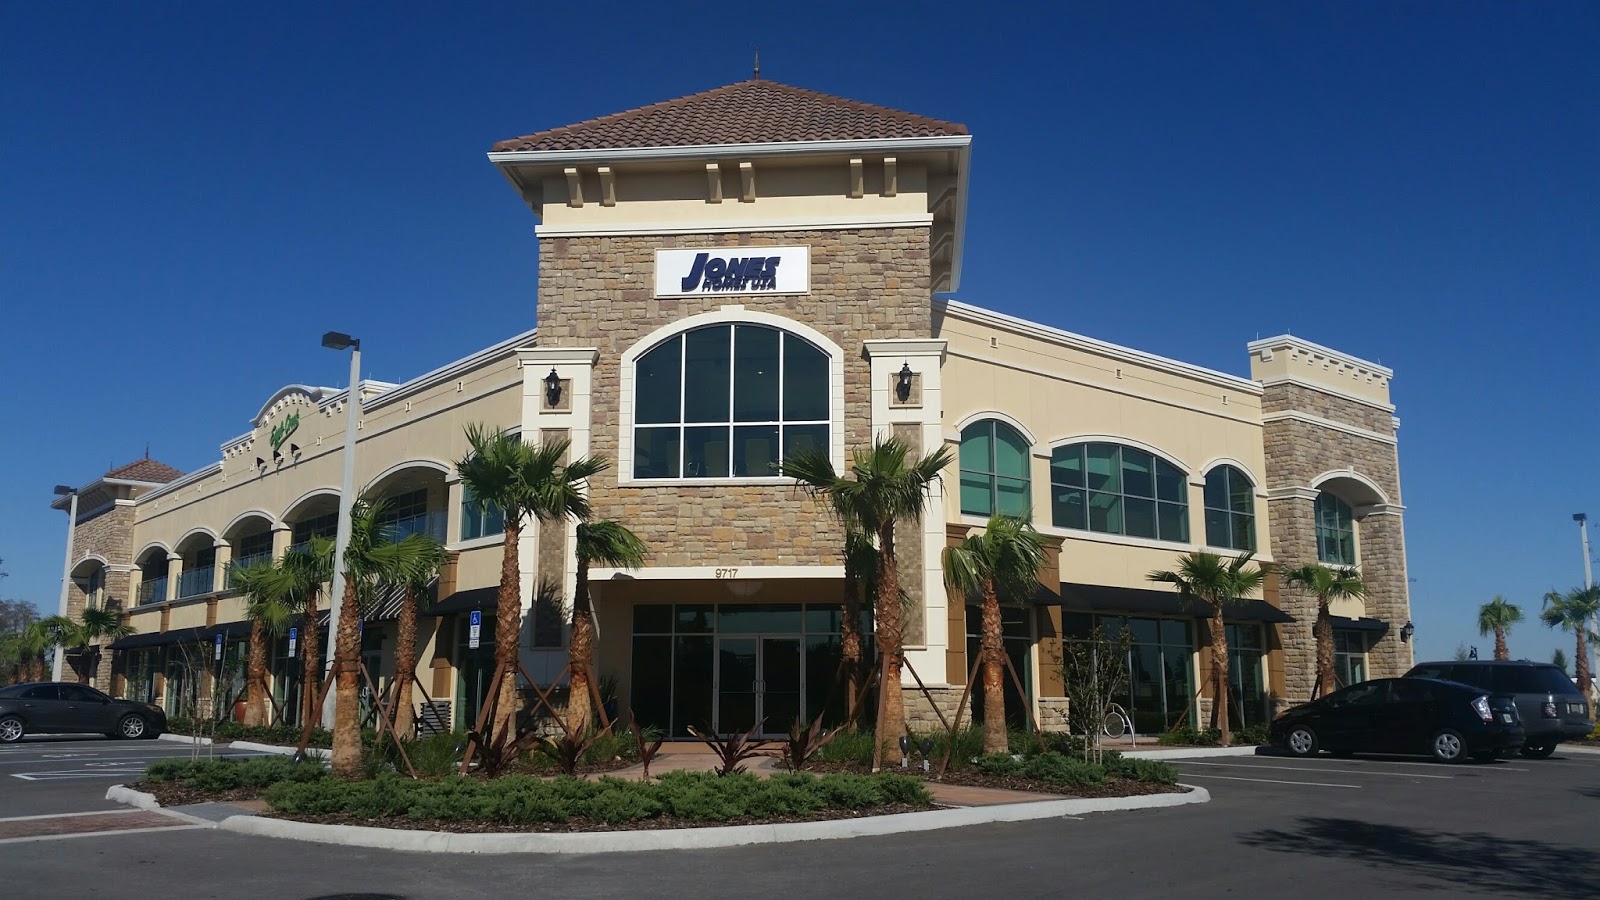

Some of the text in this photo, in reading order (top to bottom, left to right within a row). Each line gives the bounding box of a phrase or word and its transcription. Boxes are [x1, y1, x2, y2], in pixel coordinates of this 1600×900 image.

[681, 253, 781, 292] JONES
[702, 277, 750, 292] HOMES
[715, 568, 738, 578] 9717
